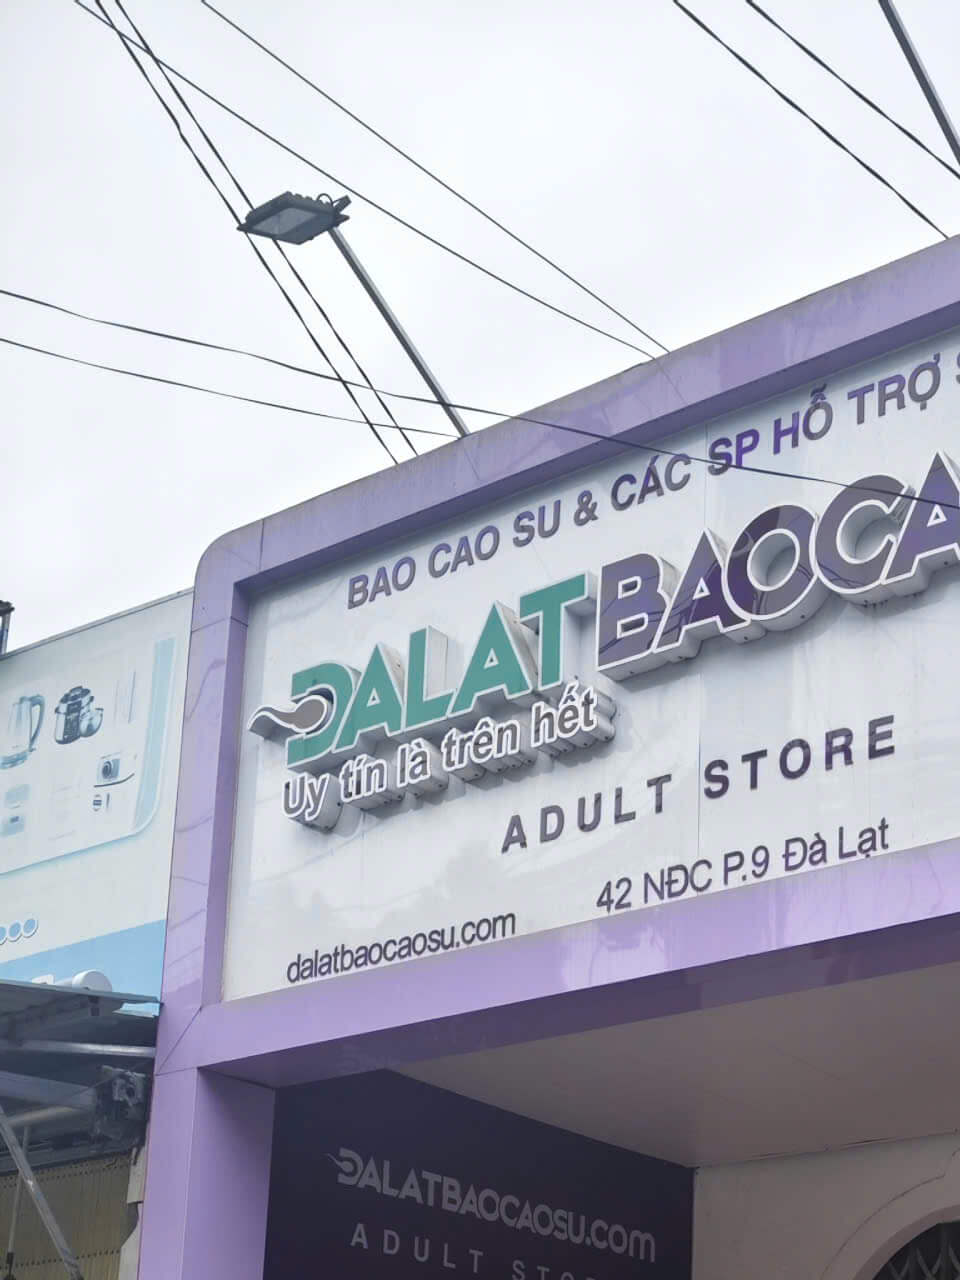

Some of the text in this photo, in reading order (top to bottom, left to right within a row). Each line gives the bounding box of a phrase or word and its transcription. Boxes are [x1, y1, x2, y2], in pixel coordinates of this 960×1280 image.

[348, 556, 416, 610] BAO
[427, 525, 500, 578] CAO
[512, 501, 561, 547] SU
[573, 490, 599, 527] &
[611, 452, 692, 512] CÁC
[708, 429, 760, 476] SP
[773, 382, 833, 455] HỖ
[848, 354, 943, 425] TRỢ
[282, 675, 598, 822] Uy tín là trên hết
[501, 715, 896, 854] ADULT STORE
[596, 817, 890, 914] 42 NĐC P.9 Đà Lạt
[286, 911, 517, 984] dalatbaocaosu.com
[350, 1223, 484, 1274] ADULT
